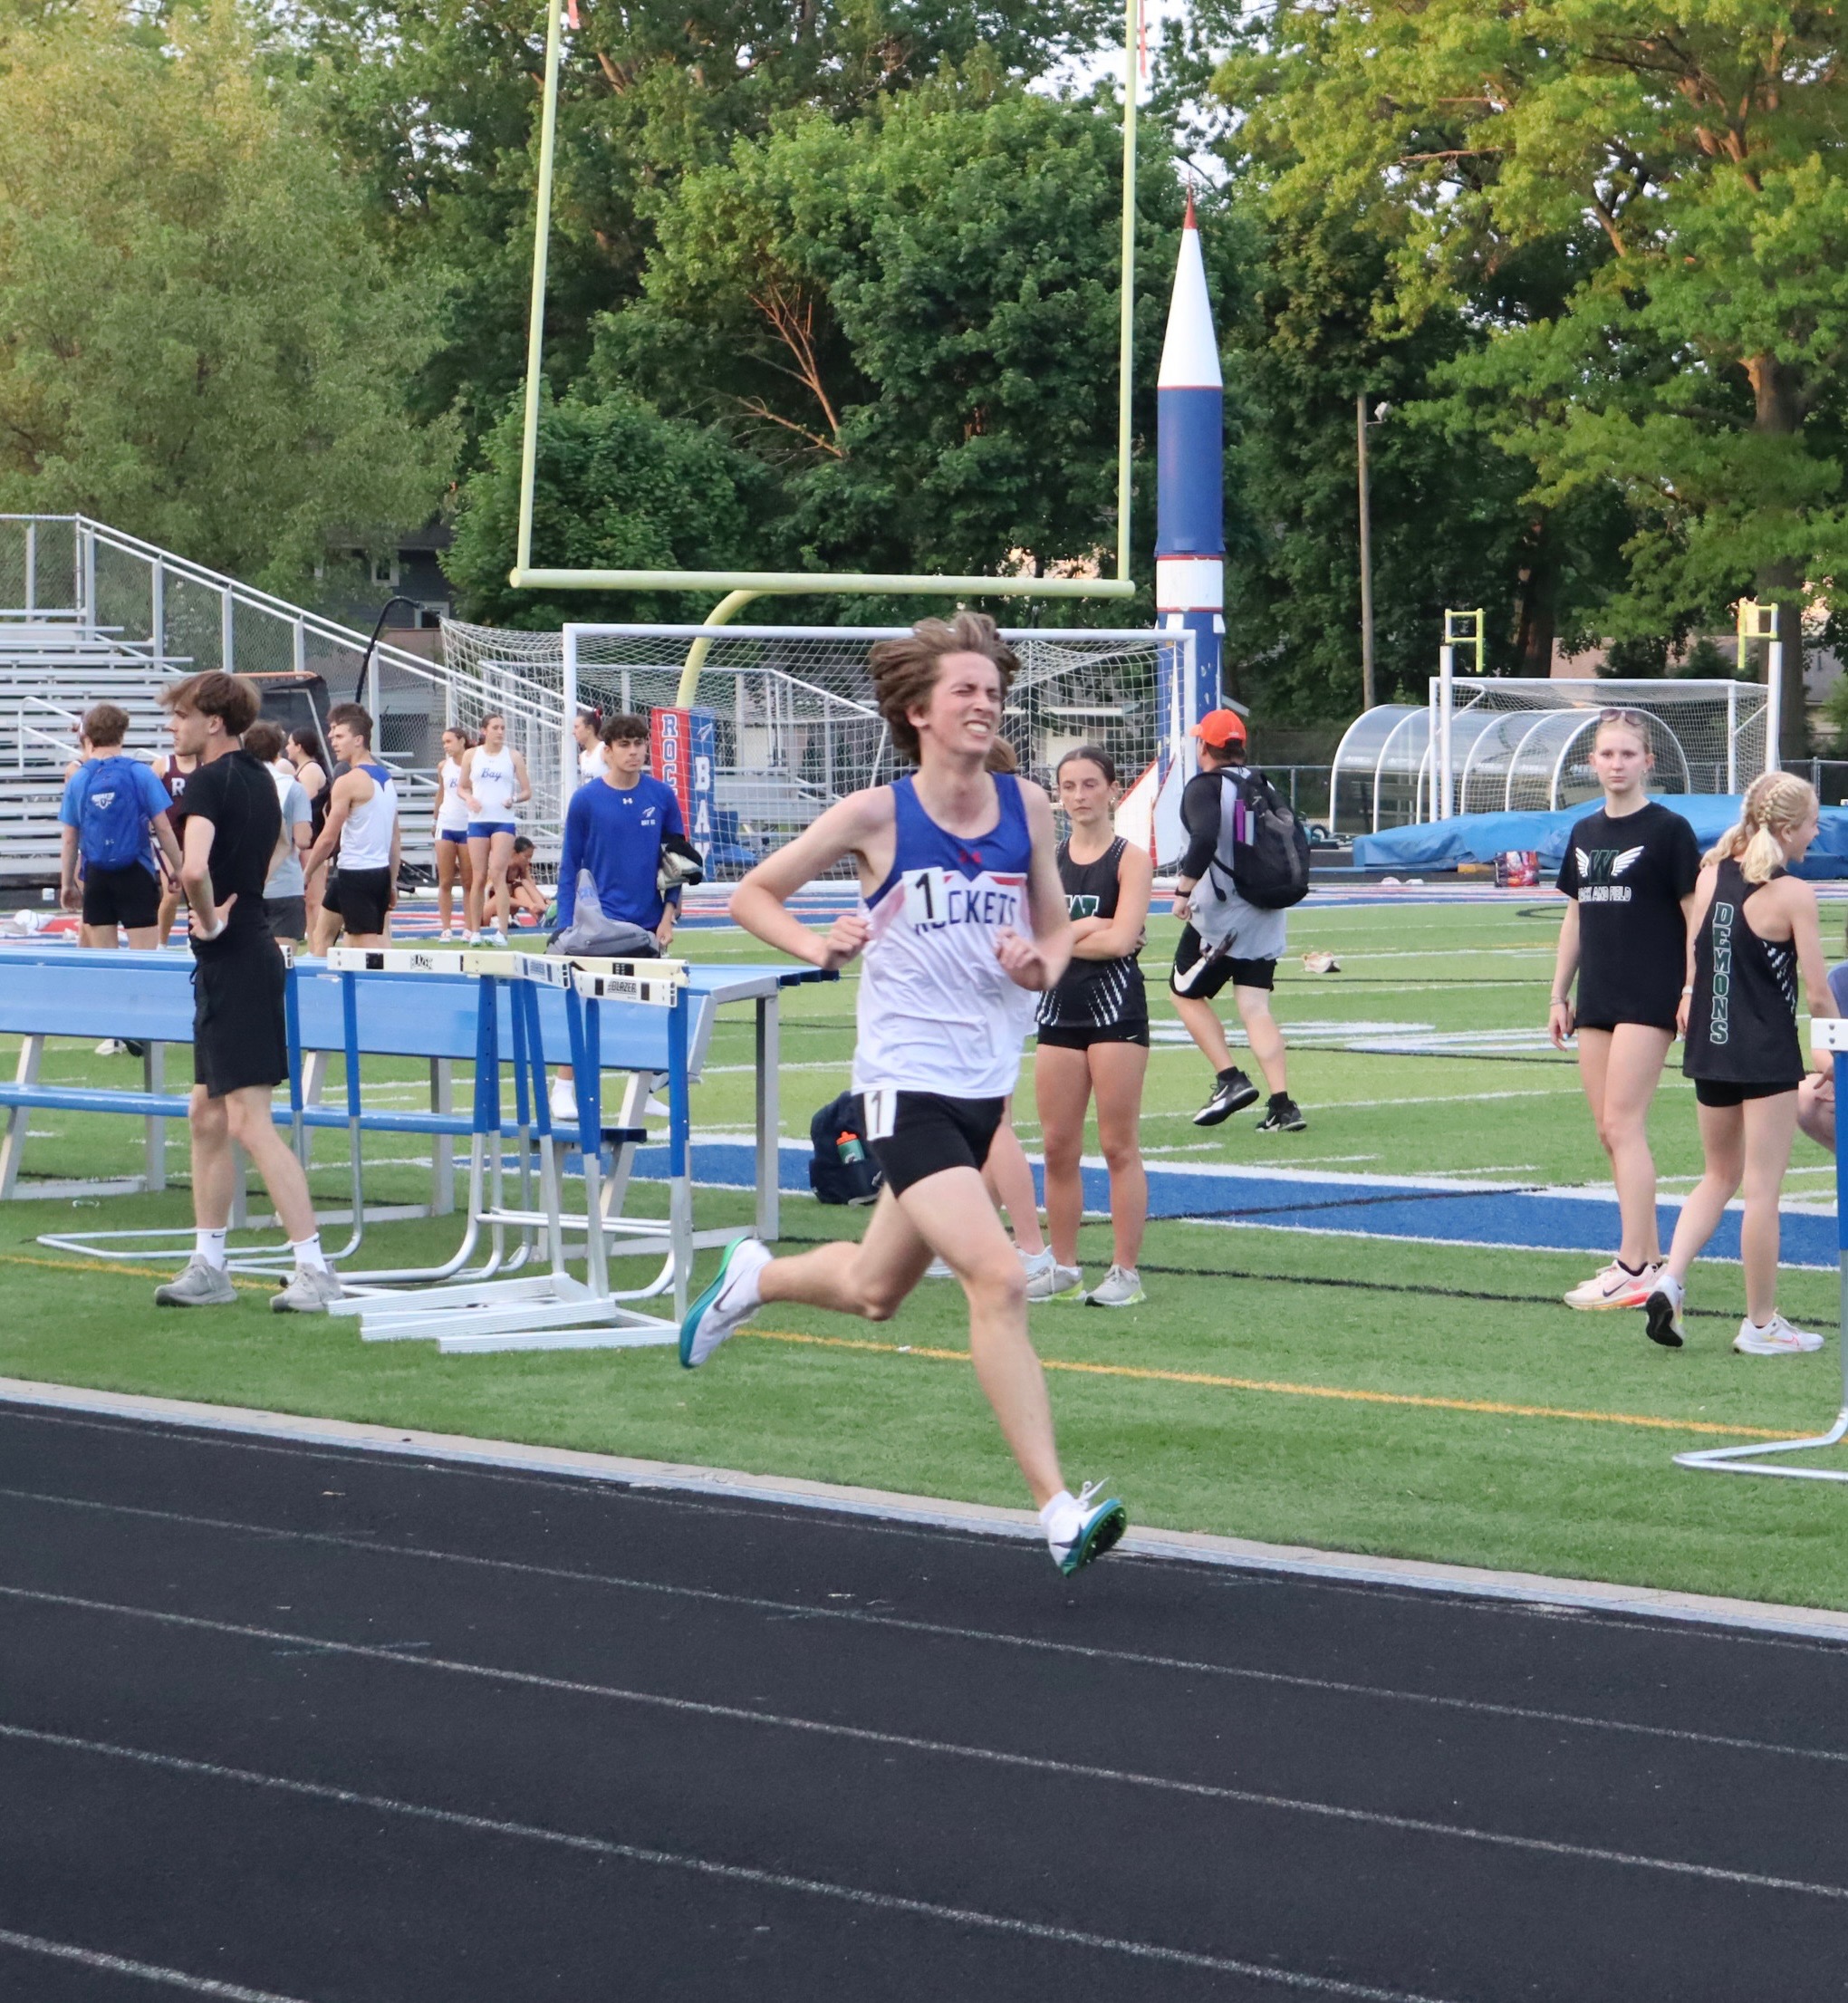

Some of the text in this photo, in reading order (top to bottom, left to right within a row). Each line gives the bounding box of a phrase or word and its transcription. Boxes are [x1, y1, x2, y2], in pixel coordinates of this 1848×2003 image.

[481, 767, 502, 782] Bay
[662, 714, 678, 796] ROC
[171, 777, 186, 796] R
[694, 756, 711, 876] BAY
[1588, 850, 1620, 885] W
[916, 872, 934, 920] 1
[916, 890, 1016, 935] CKETS
[1593, 886, 1609, 901] AND
[1609, 886, 1631, 901] FIELD
[607, 980, 637, 994] BLAZER
[1709, 901, 1734, 1045] DEMONS
[871, 1090, 882, 1134] 1
